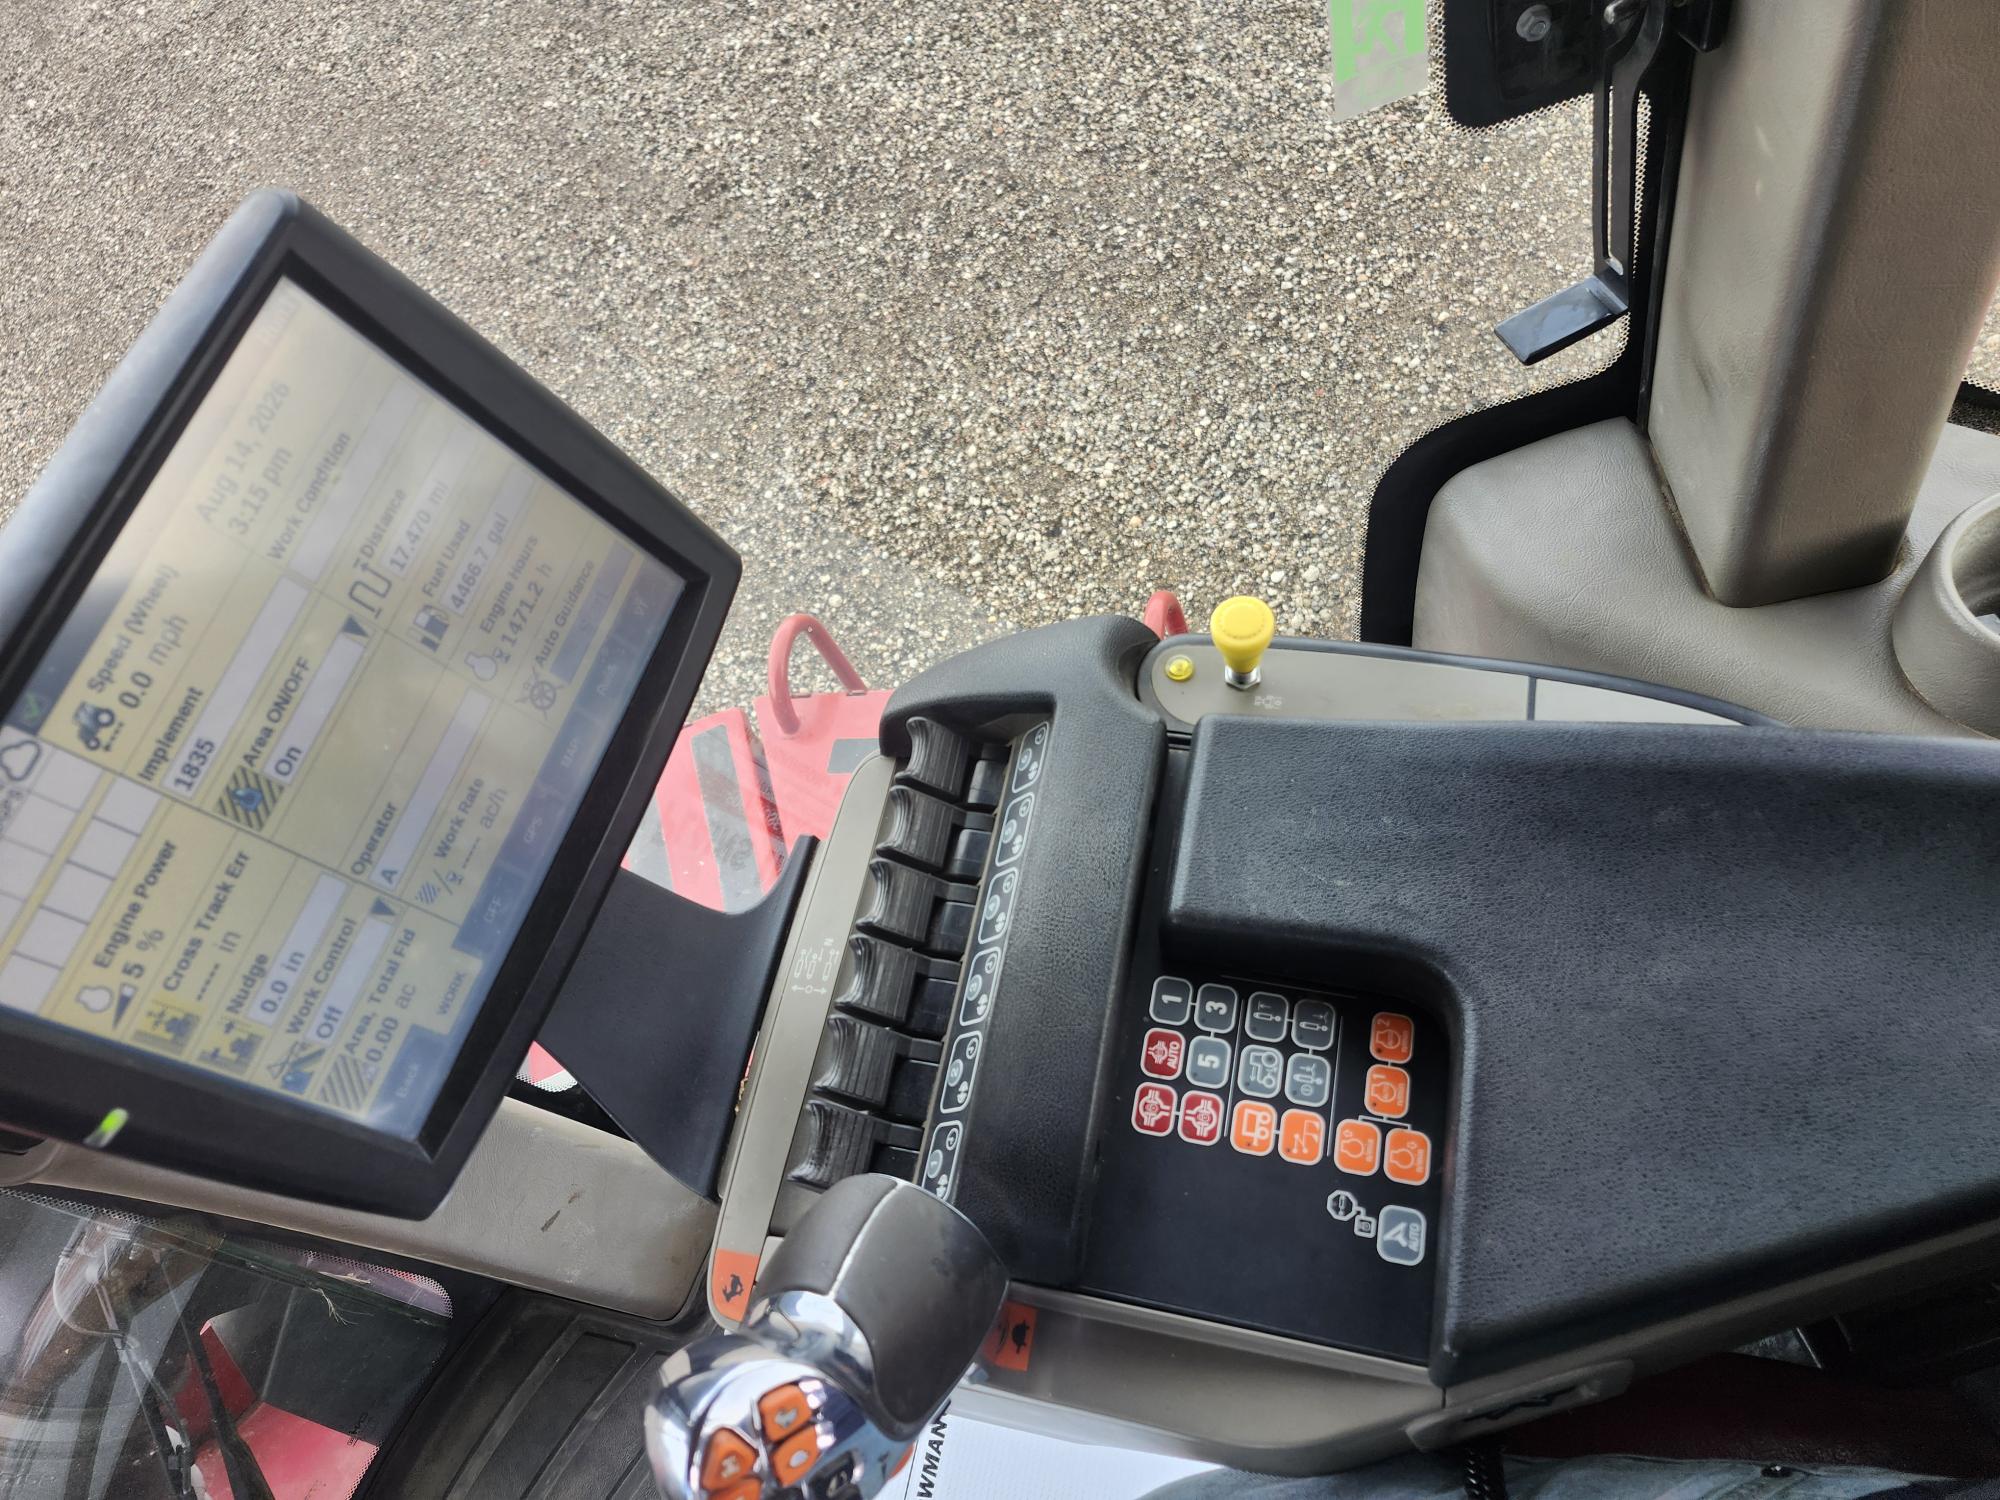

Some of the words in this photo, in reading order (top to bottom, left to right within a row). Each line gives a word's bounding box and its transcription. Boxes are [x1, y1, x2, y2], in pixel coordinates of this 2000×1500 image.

[226, 481, 271, 537] 3:15
[260, 443, 297, 487] pm
[265, 512, 303, 562] Work
[293, 429, 352, 515] Condition
[359, 486, 407, 559] Distance
[388, 506, 433, 572] 17.470
[420, 559, 449, 598] Fuel
[440, 517, 471, 562] Used
[483, 511, 511, 546] gal
[478, 578, 518, 636] Engine
[506, 531, 539, 581] Hours
[499, 579, 544, 648] 1471.2
[535, 559, 553, 578] h
[533, 626, 560, 667] Auto
[553, 557, 595, 628] Guidance
[85, 633, 137, 696] Speed
[123, 561, 180, 636] (Wheel)
[116, 668, 155, 711] 0.0
[142, 610, 193, 669] mph
[137, 685, 207, 783] Implement
[240, 723, 274, 767] Area
[264, 655, 313, 725] ON/OFF
[172, 735, 217, 792] 1835
[272, 743, 303, 778] On
[349, 800, 401, 877] Operator
[433, 814, 465, 860] Work
[457, 775, 485, 814] Rate
[476, 785, 508, 829] ac/h
[91, 899, 147, 970] Engine
[131, 838, 178, 899] Power
[378, 865, 398, 884] A
[120, 959, 147, 979] 5
[134, 925, 166, 954] %
[160, 935, 204, 993] Cross
[194, 879, 235, 932] Track
[224, 849, 251, 879] Err
[213, 928, 242, 953] in
[225, 951, 273, 1016] Nudge
[258, 978, 290, 1014] 0.0
[279, 948, 305, 973] in
[285, 986, 321, 1036] Work
[312, 916, 357, 984] Control
[342, 1008, 377, 1055] Area,
[367, 958, 400, 1005] Total
[392, 927, 416, 957] Fld
[435, 969, 466, 1017] WORK
[1161, 994, 1183, 1004] 1
[1205, 1001, 1228, 1016] 3
[312, 1004, 344, 1040] Off
[364, 1015, 400, 1063] 0.00
[393, 982, 417, 1010] ac
[1166, 1041, 1181, 1070] AUTO
[1197, 1053, 1220, 1070] 5
[1407, 1222, 1420, 1253] AUTO
[916, 1412, 948, 1499] WMAN
